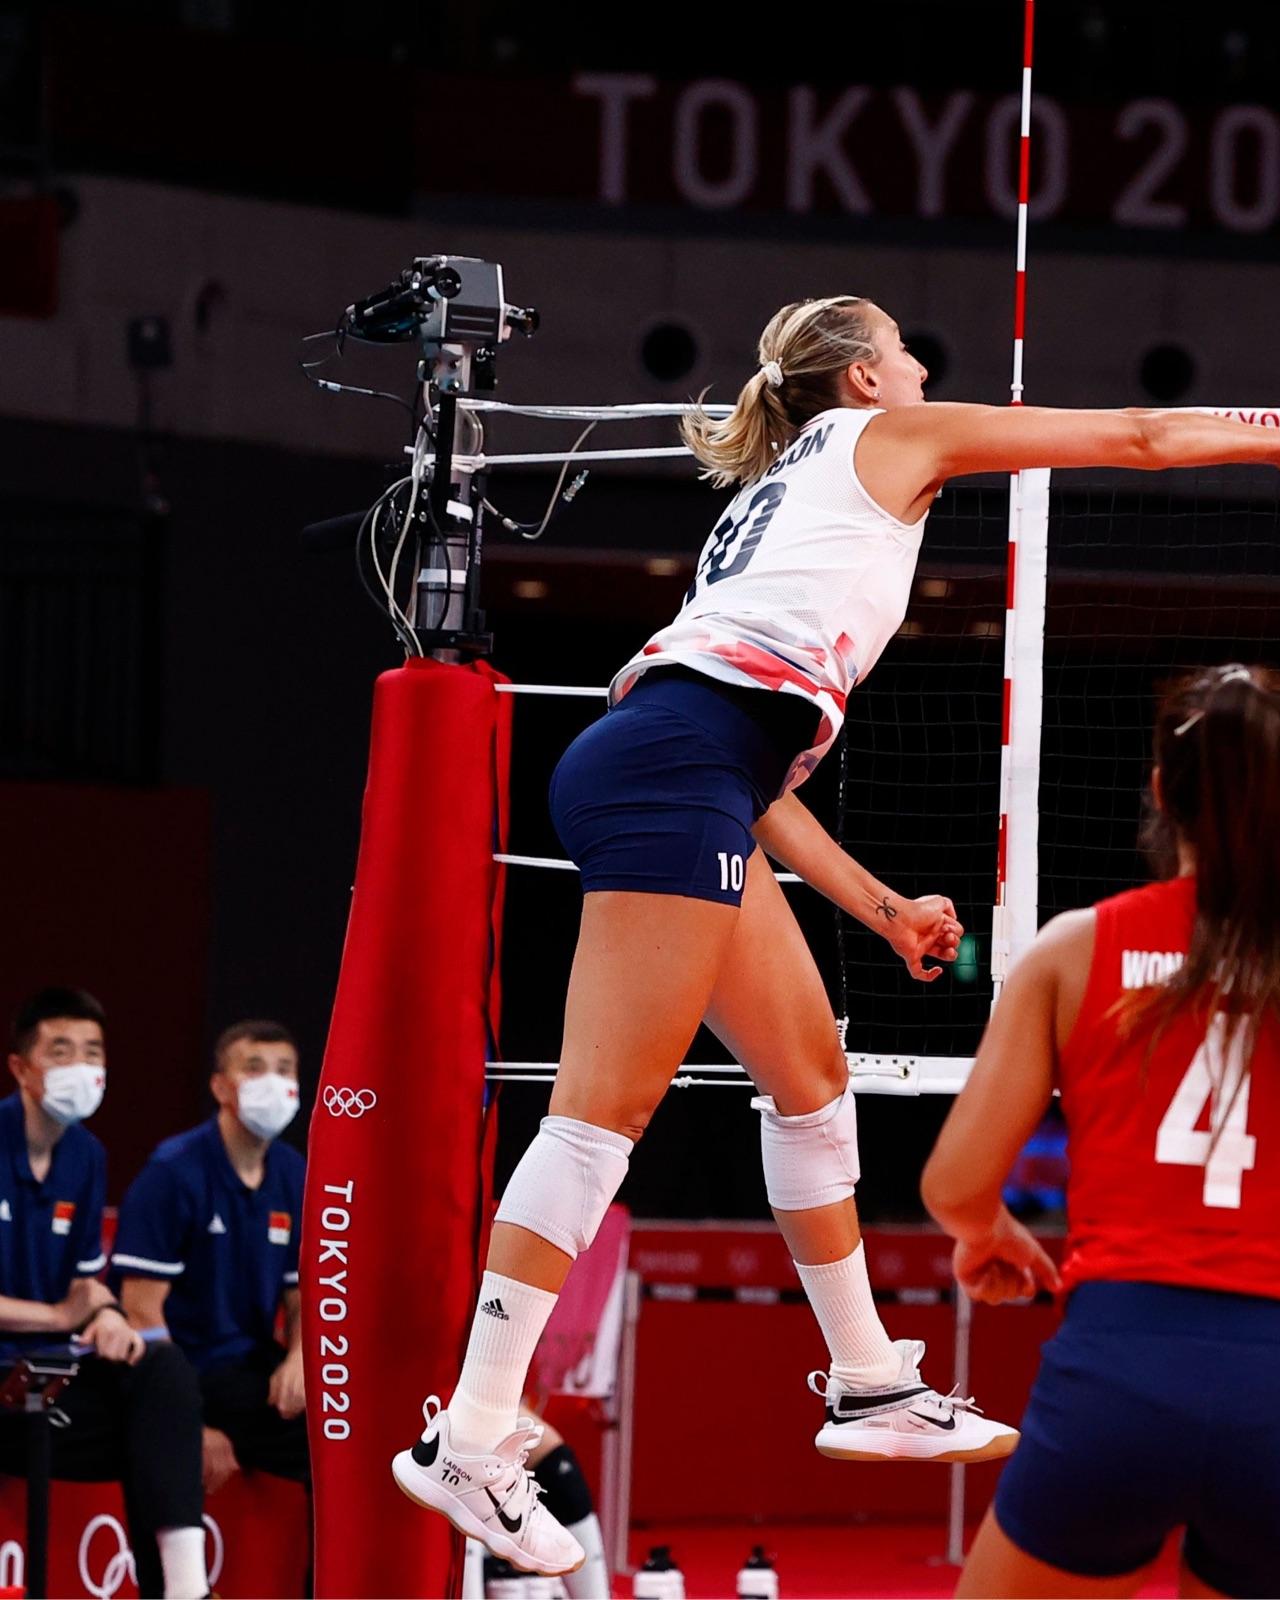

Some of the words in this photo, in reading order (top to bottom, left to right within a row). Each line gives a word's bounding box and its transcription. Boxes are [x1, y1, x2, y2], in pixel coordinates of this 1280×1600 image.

[573, 72, 1068, 222] TOKYO
[718, 853, 743, 891] 10
[1155, 1012, 1257, 1209] 4
[319, 1180, 354, 1322] TOKYO
[480, 1304, 509, 1321] adidas
[320, 1335, 351, 1440] 2020
[442, 1457, 472, 1482] LARSON
